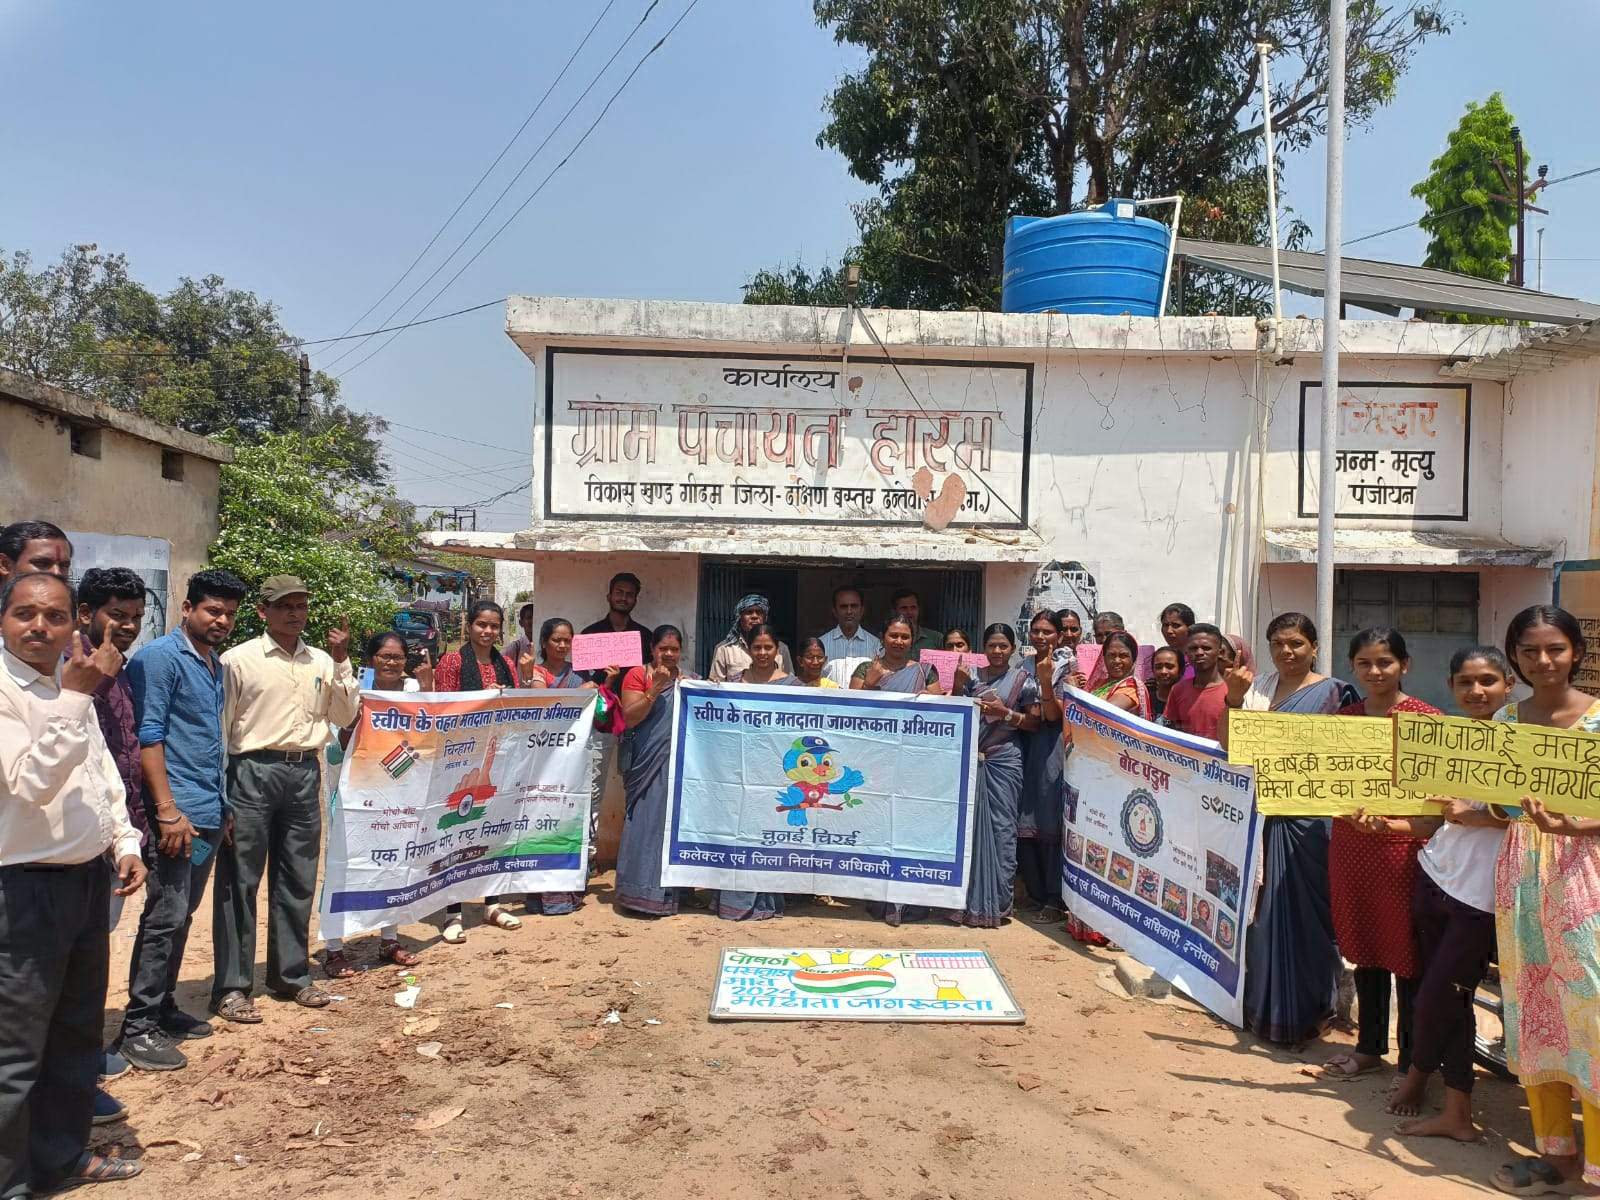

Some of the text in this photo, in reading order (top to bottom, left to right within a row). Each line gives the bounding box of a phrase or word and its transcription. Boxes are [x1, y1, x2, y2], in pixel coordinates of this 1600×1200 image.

[723, 364, 840, 392] कार्यालय
[568, 393, 1002, 475] ग्राम पंचायत हारम
[1391, 451, 1435, 480] मृत्यु
[584, 473, 636, 507] विकास
[640, 482, 673, 505] खण्ड
[832, 487, 876, 515] बस्तर
[1348, 476, 1417, 504] पंजीयन
[371, 706, 412, 731] स्वीप
[415, 708, 434, 731] के
[435, 714, 459, 732] तहत
[460, 711, 493, 727] मतदाता
[544, 702, 582, 720] अभियान
[694, 702, 956, 737] स्वीप के तहत मतदाता जागरूकता अभियान
[1399, 714, 1444, 747] जागो
[1446, 720, 1497, 751] जागो
[1203, 759, 1250, 791] अभियान
[1255, 758, 1271, 774] 18
[1399, 751, 1442, 784] तुम
[1446, 757, 1506, 787] भारत
[1498, 750, 1526, 789] के
[1256, 775, 1293, 798] मिला
[1331, 780, 1355, 798] का
[1361, 780, 1393, 798] अब
[371, 848, 399, 867] एक
[405, 841, 436, 861] निशान
[480, 819, 511, 838] निर्माण
[514, 815, 530, 830] की
[535, 814, 560, 832] ओर
[761, 827, 808, 846] चुनई
[679, 847, 952, 883] कलेक्टर एवं जिला निर्वाचन अधिकारी, दन्तेवाड़ा
[1091, 883, 1110, 904] जिला
[1112, 895, 1142, 922] निर्वाचन
